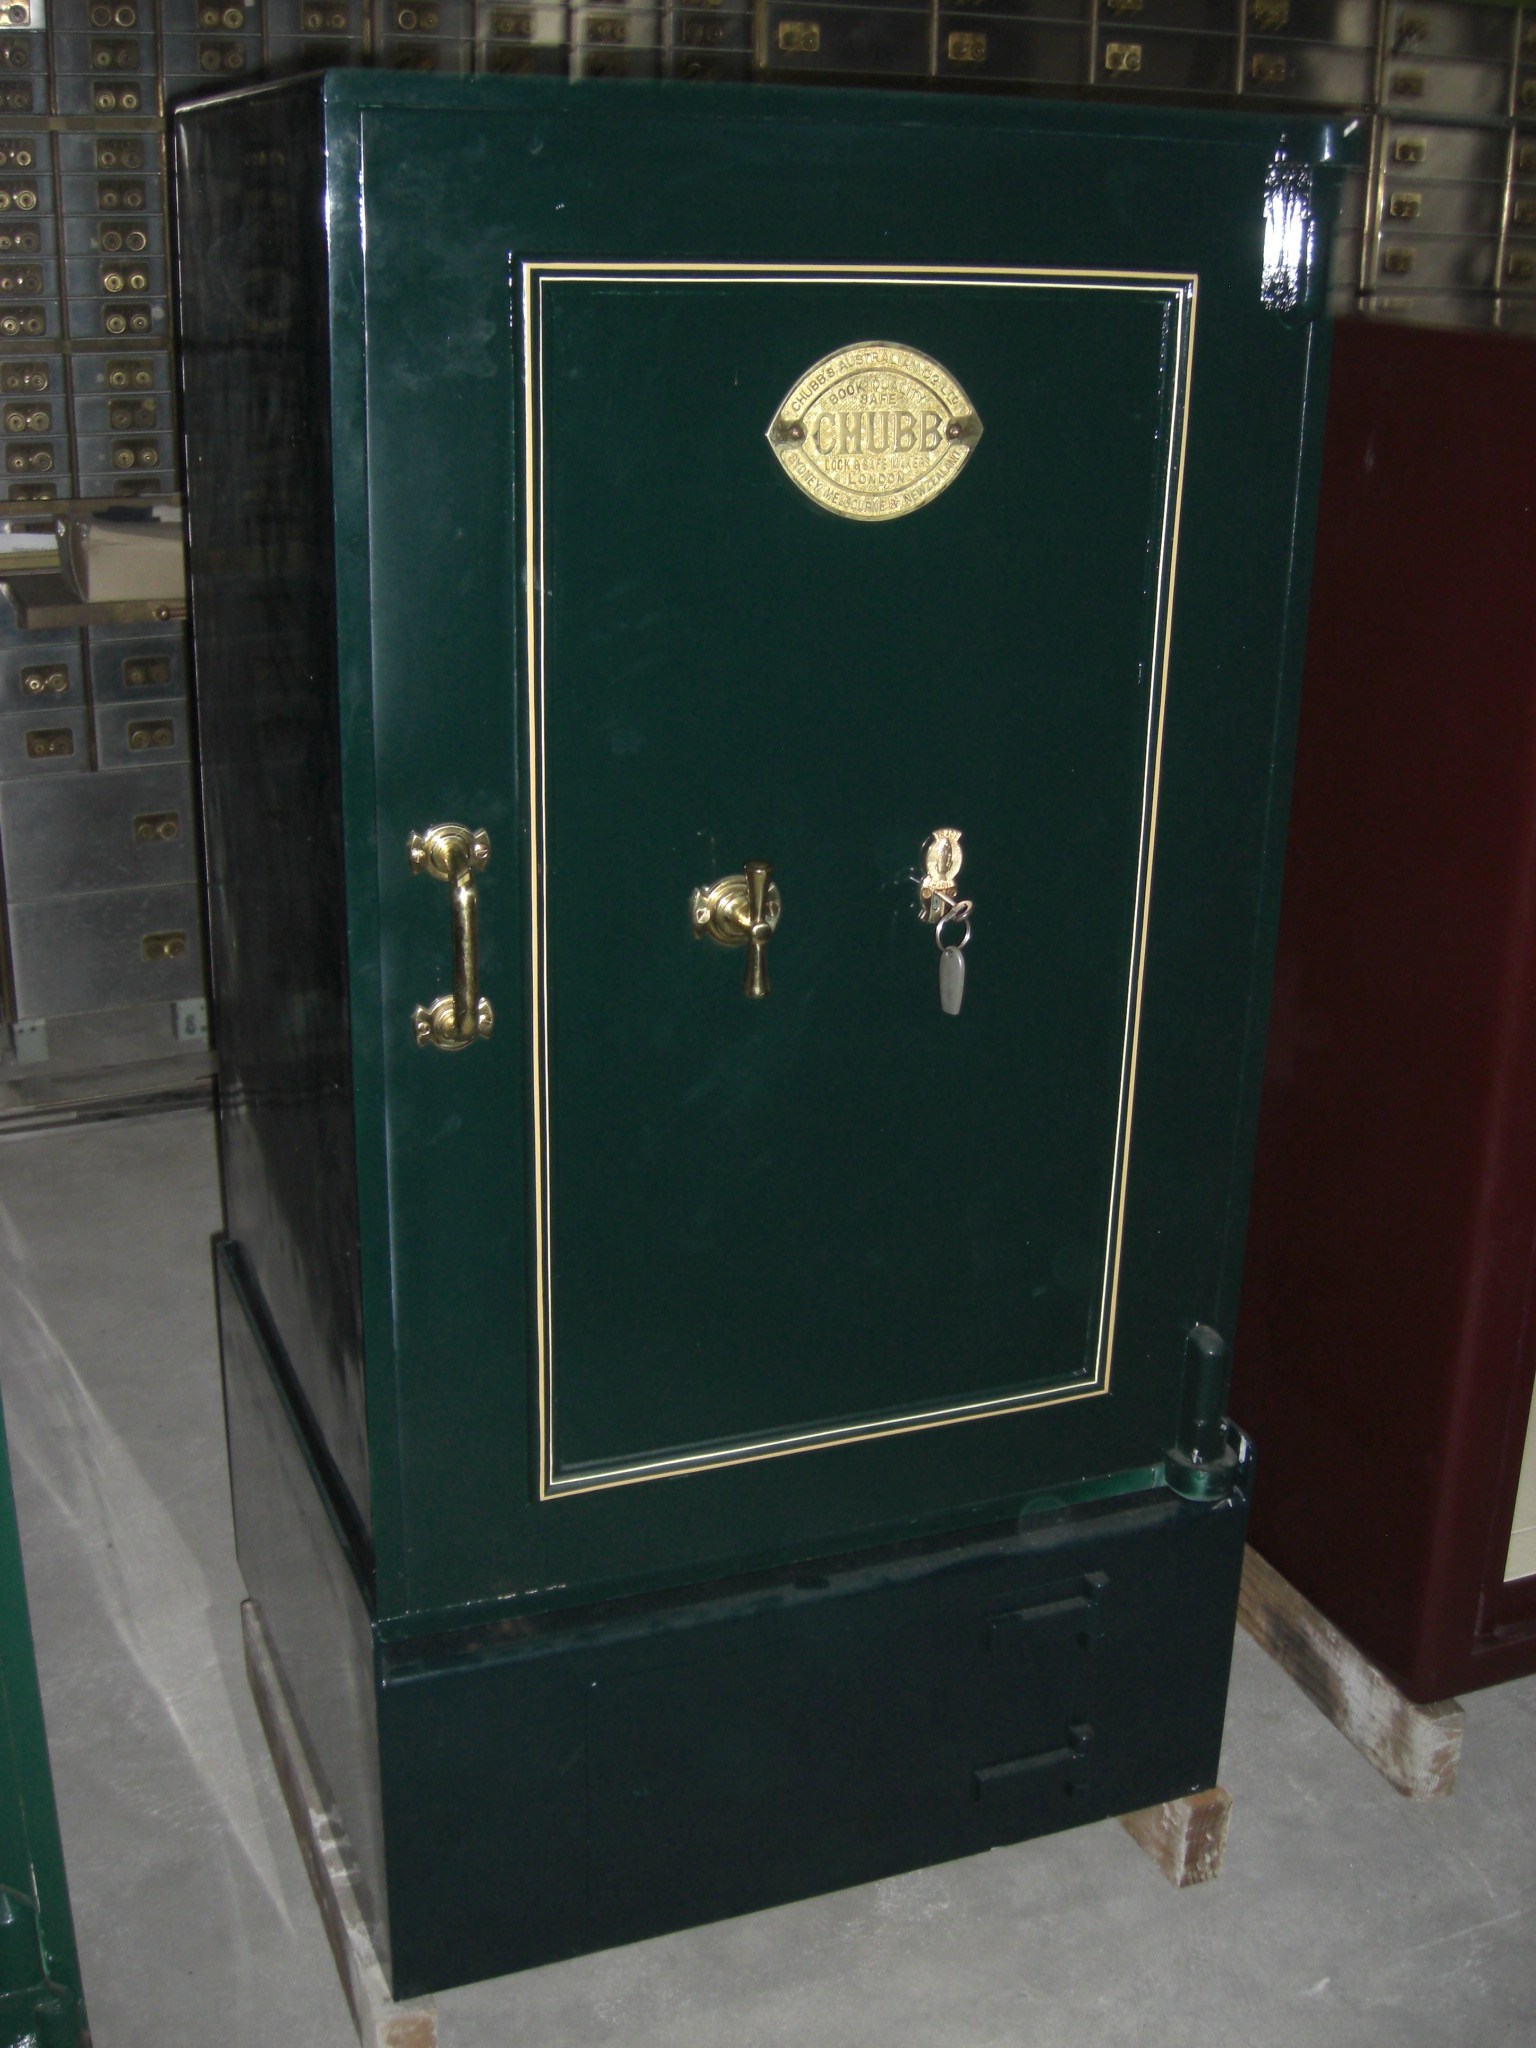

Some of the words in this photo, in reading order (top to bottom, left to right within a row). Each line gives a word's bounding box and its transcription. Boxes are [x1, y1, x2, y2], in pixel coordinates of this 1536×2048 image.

[860, 394, 896, 404] SAFE
[812, 410, 944, 455] CHUBB
[825, 459, 851, 471] LOCK
[862, 459, 886, 470] SAFE
[788, 452, 823, 491] SYDNEY
[849, 473, 904, 485] LONDON
